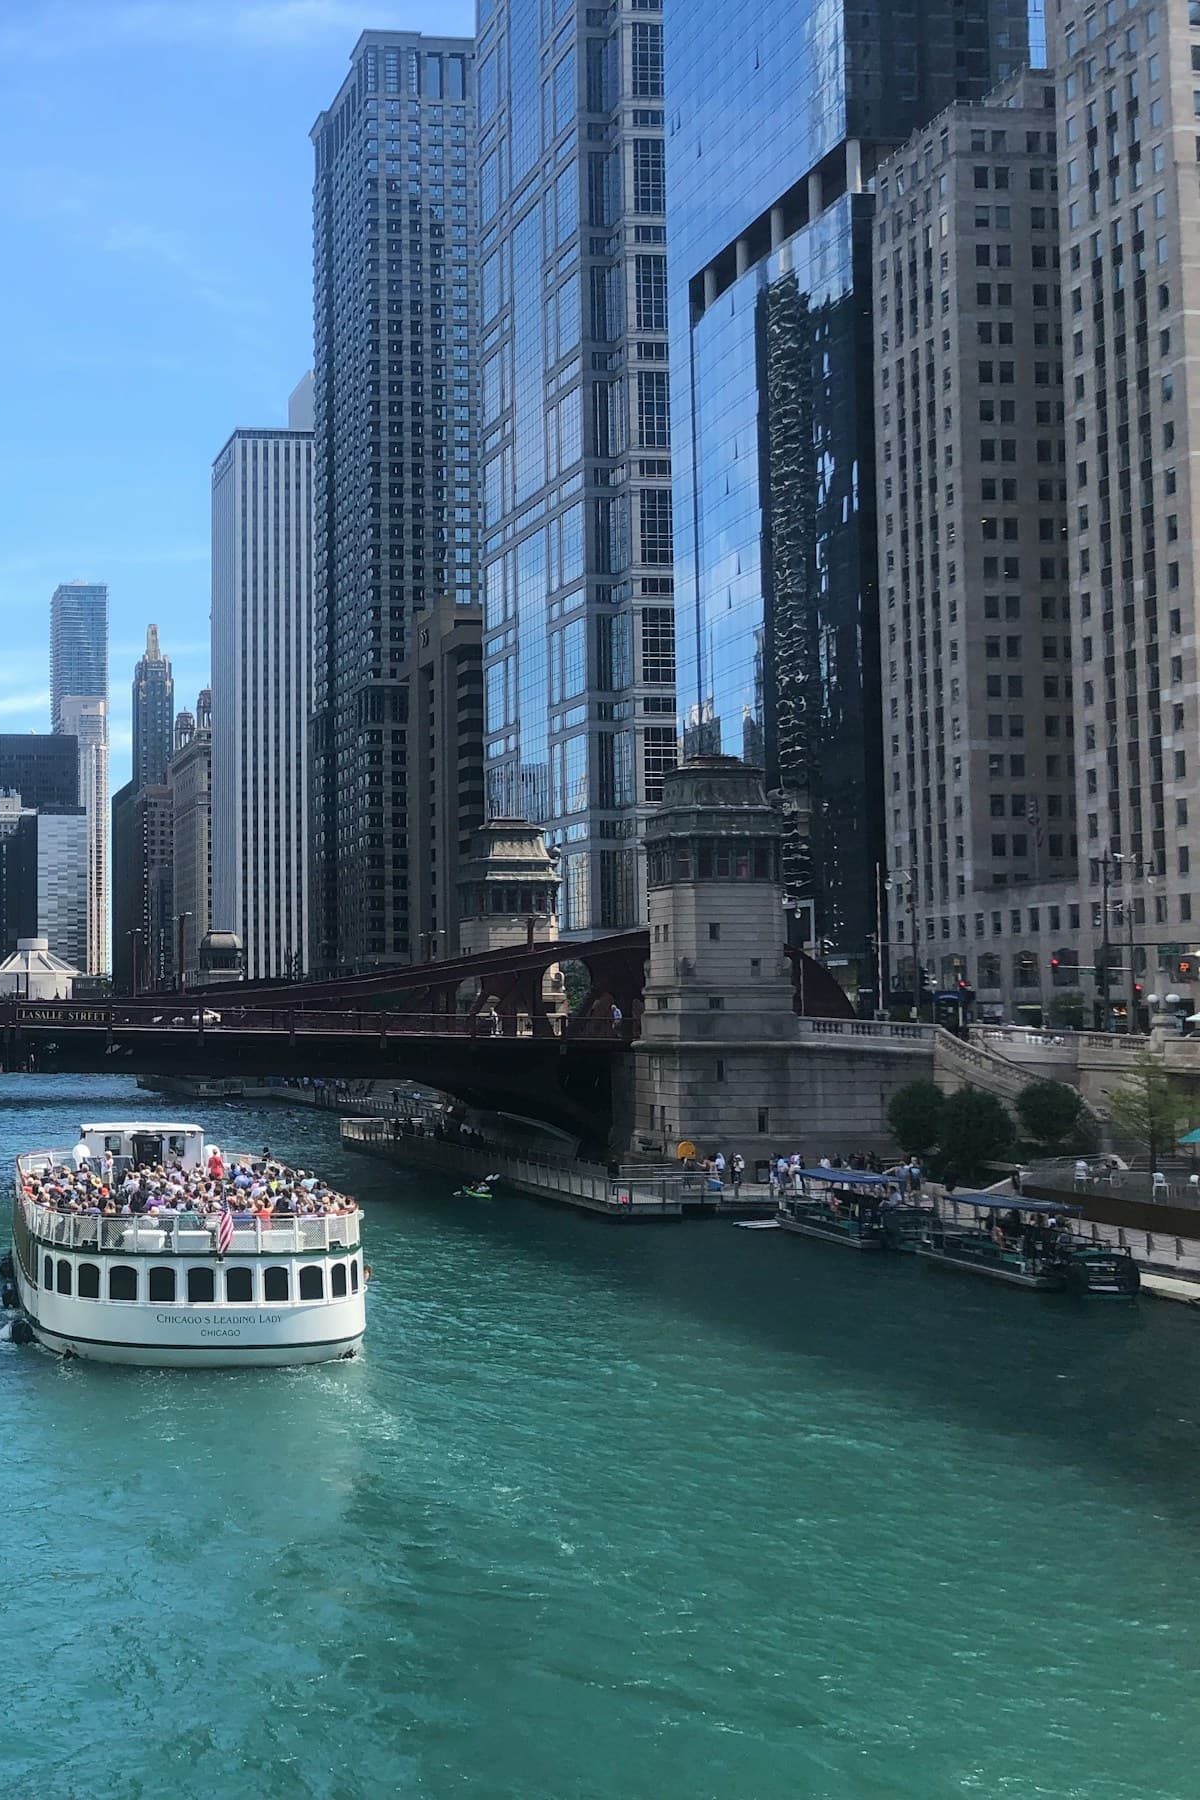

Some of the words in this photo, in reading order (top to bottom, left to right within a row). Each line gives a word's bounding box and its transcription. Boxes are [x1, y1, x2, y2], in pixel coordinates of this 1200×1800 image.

[68, 1012, 106, 1021] STREET
[213, 1315, 256, 1325] LEADING
[259, 1314, 282, 1324] LADY
[200, 1329, 241, 1337] CHICAGO
